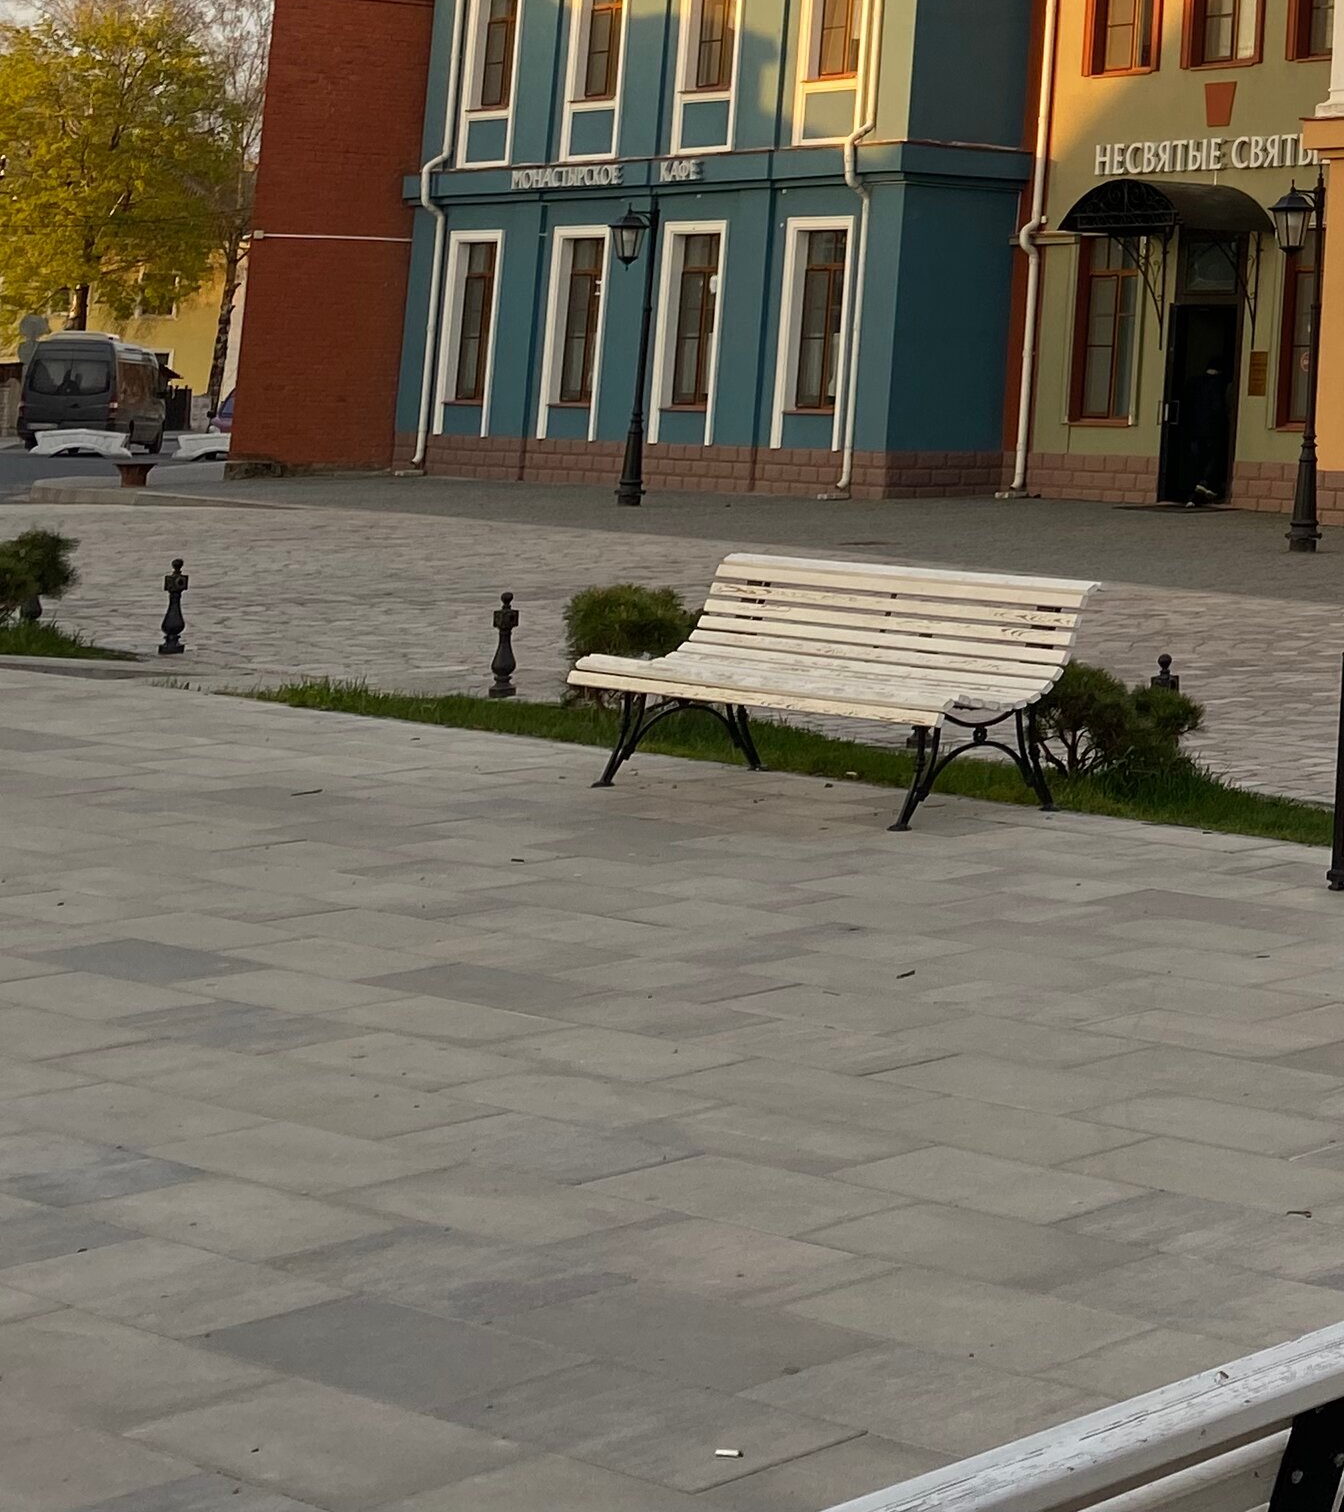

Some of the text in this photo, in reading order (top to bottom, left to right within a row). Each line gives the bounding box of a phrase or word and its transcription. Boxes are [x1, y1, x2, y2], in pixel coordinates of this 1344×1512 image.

[1094, 133, 1331, 175] НЕСВЯТЫЕ СВЯТЫ
[511, 159, 702, 189] МОНАСТЫРСКОЕ КАФЕ
